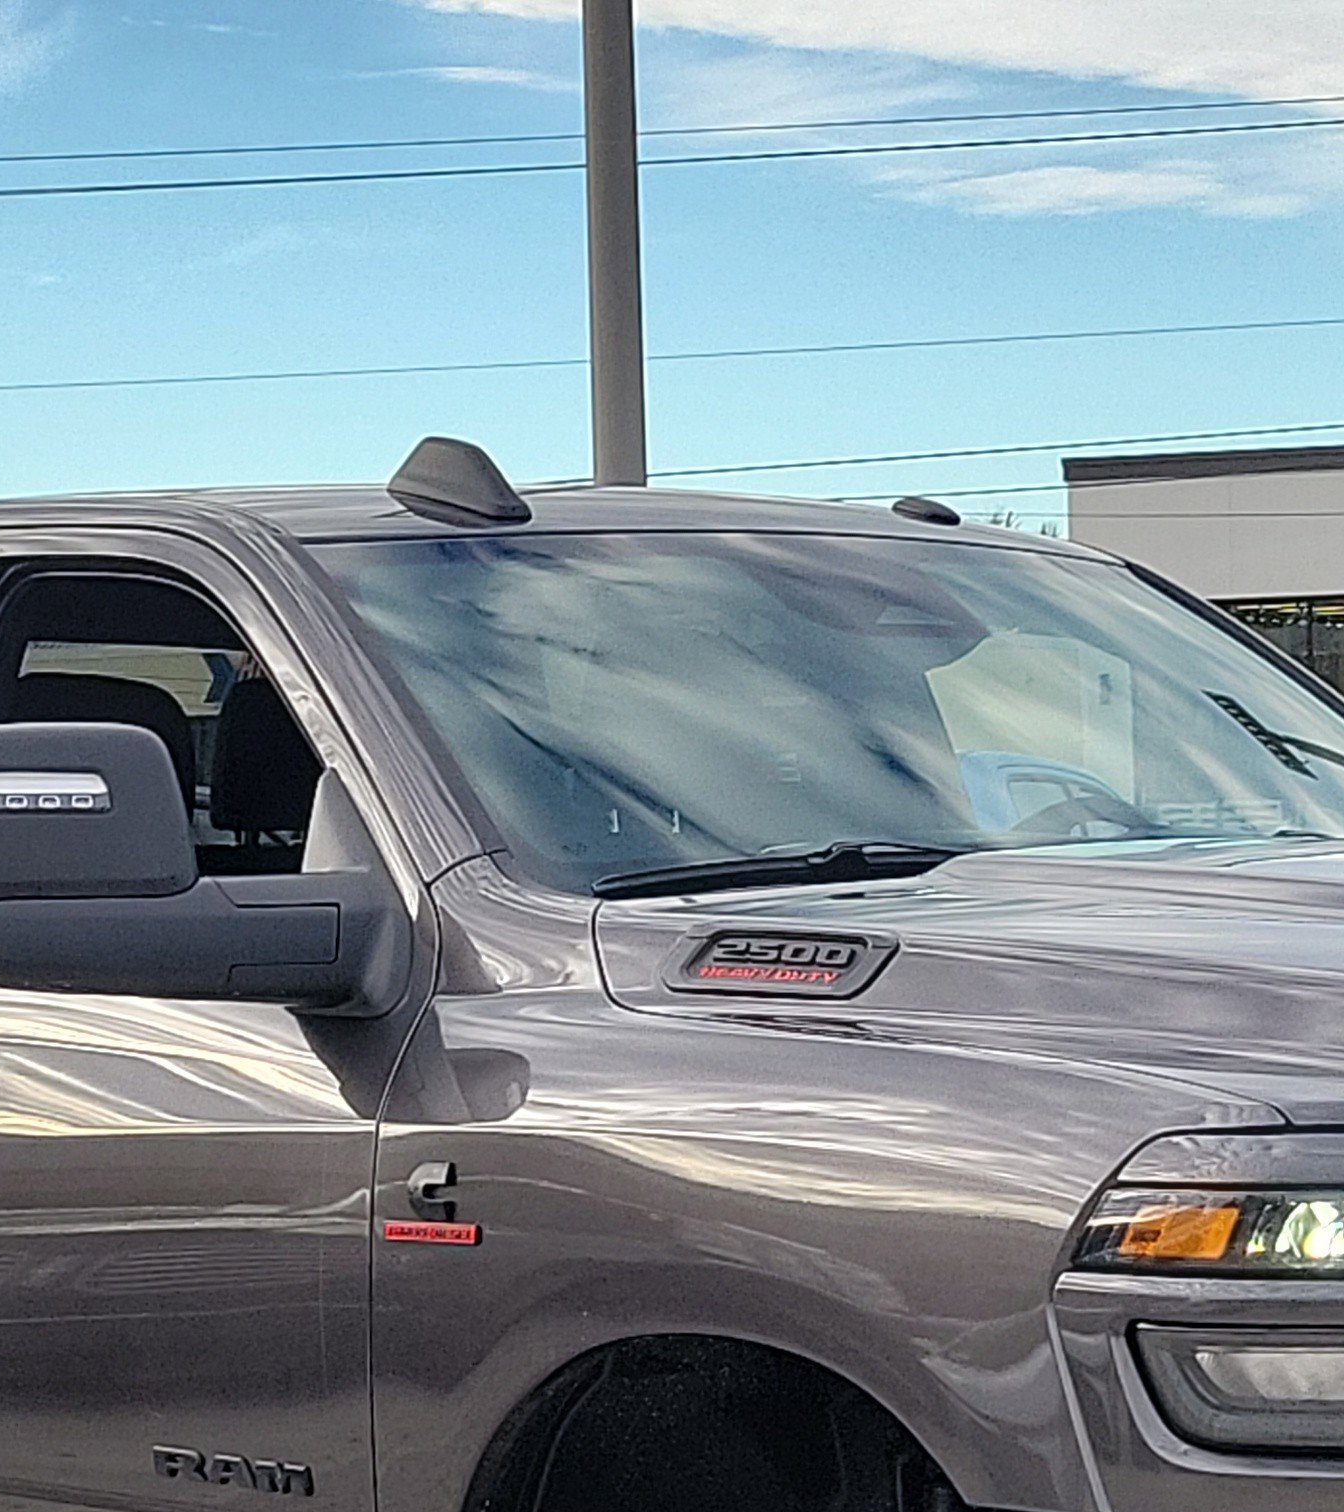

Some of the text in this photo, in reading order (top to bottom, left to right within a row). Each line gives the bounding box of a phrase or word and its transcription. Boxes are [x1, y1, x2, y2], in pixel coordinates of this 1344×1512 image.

[712, 940, 854, 968] 2500
[699, 966, 840, 984] HEAVY DUTY
[152, 1444, 314, 1497] RAM
